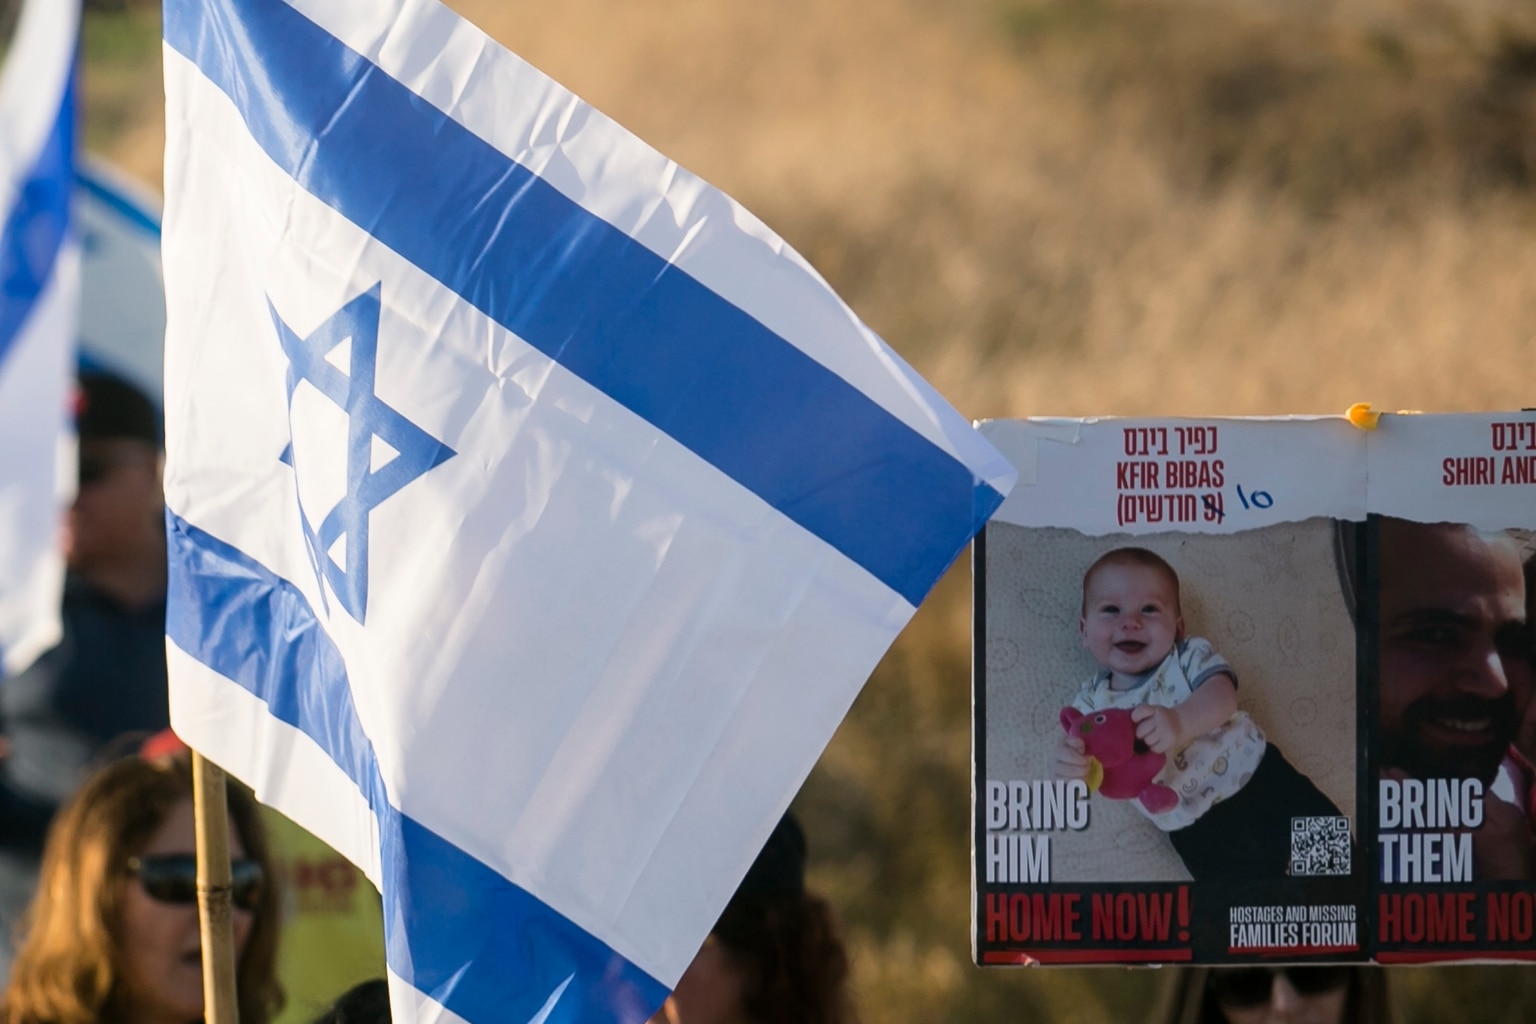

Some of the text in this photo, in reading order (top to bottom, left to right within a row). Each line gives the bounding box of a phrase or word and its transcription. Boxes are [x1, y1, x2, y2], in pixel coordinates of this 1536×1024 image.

[1123, 426, 1218, 456] כפיר ביבס
[1117, 460, 1224, 489] KFIR BIBAS
[1442, 456, 1495, 486] SHIRI
[1236, 483, 1274, 510] 10
[986, 779, 1090, 831] BRING
[1379, 777, 1483, 829] BRING
[986, 834, 1051, 883] HIM
[1378, 833, 1473, 883] THEM
[985, 885, 1191, 942] HOME NOW!
[1230, 905, 1356, 923] HOSTAGES AND MISSING
[1378, 891, 1536, 943] HOME NO
[1230, 922, 1357, 947] FAMILIES FORUM
